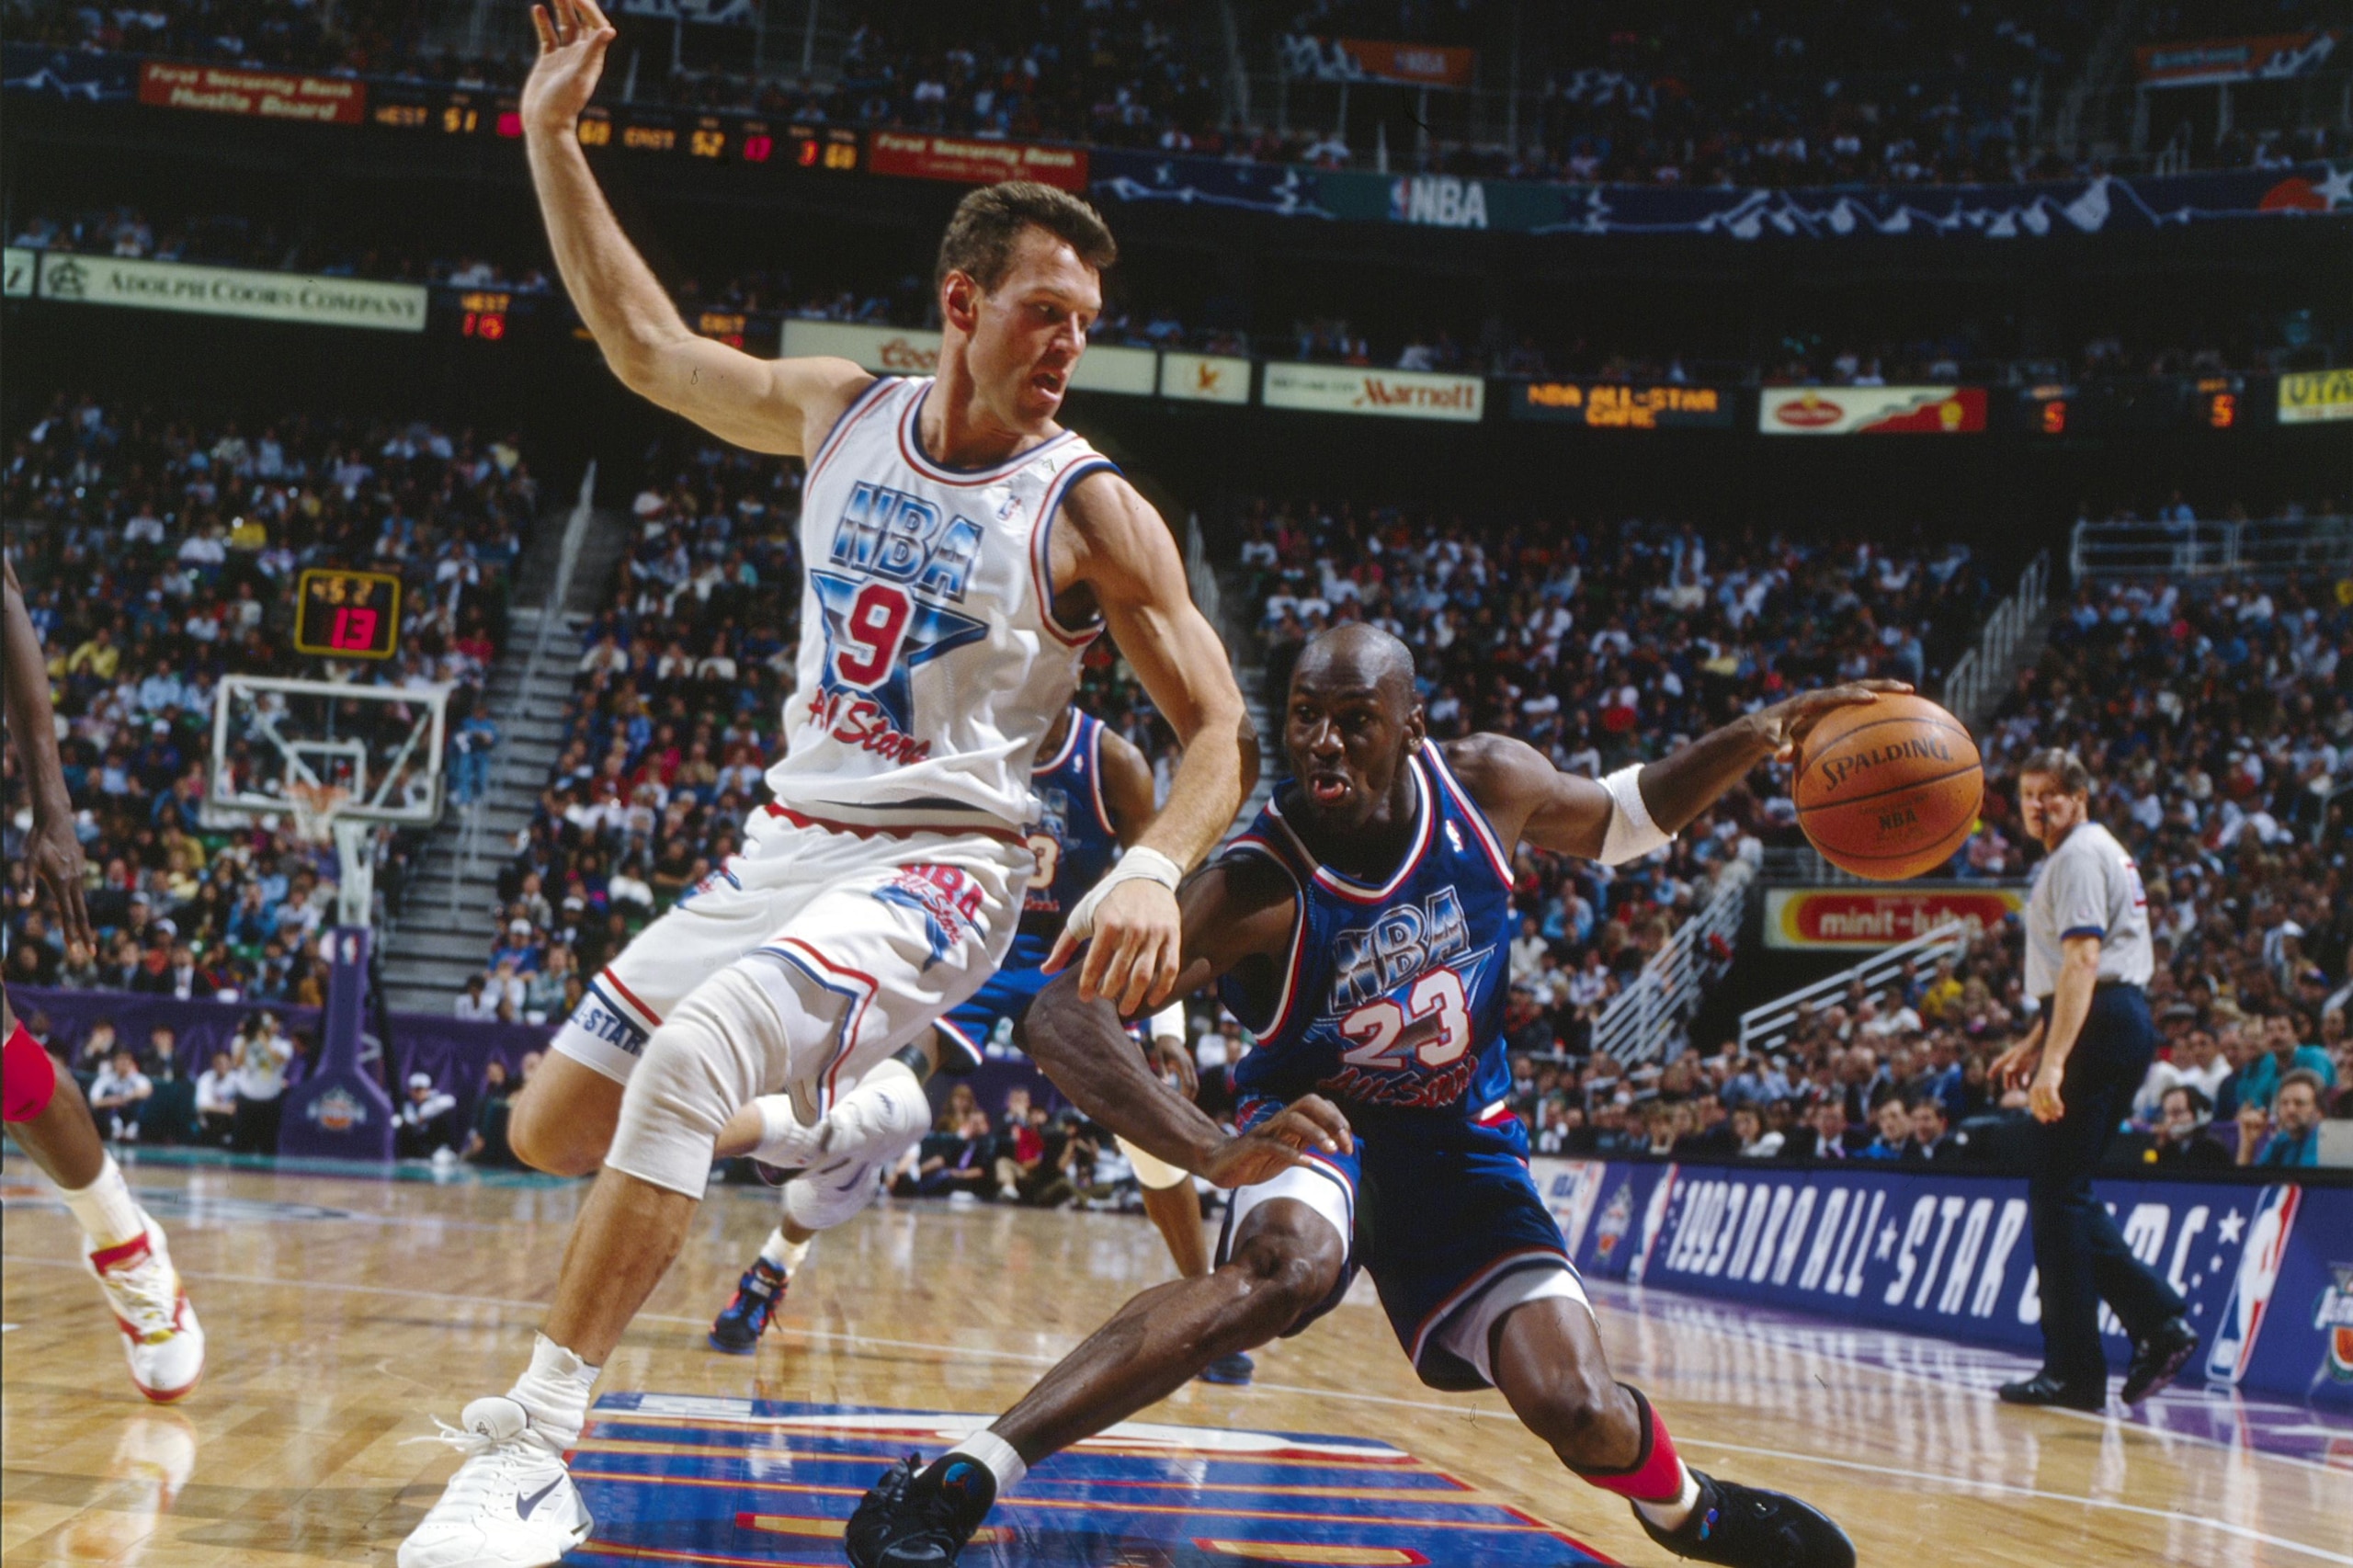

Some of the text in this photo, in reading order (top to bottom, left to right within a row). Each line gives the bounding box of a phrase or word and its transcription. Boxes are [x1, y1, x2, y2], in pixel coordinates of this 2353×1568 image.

[259, 94, 338, 120] Board
[1408, 176, 1489, 229] NBA
[1353, 368, 1476, 410] Marriott
[829, 481, 984, 605] NBA
[331, 607, 379, 651] 13
[830, 576, 916, 692] 9
[1821, 736, 1954, 792] SPALDING
[1879, 808, 1919, 830] NBA
[1329, 884, 1472, 1016] NBA
[1338, 965, 1472, 1069] 23
[1665, 1179, 1746, 1277] 1993
[1726, 1183, 1819, 1287] NBA
[1798, 1187, 1887, 1298] ALL
[1883, 1194, 2029, 1319] STAR
